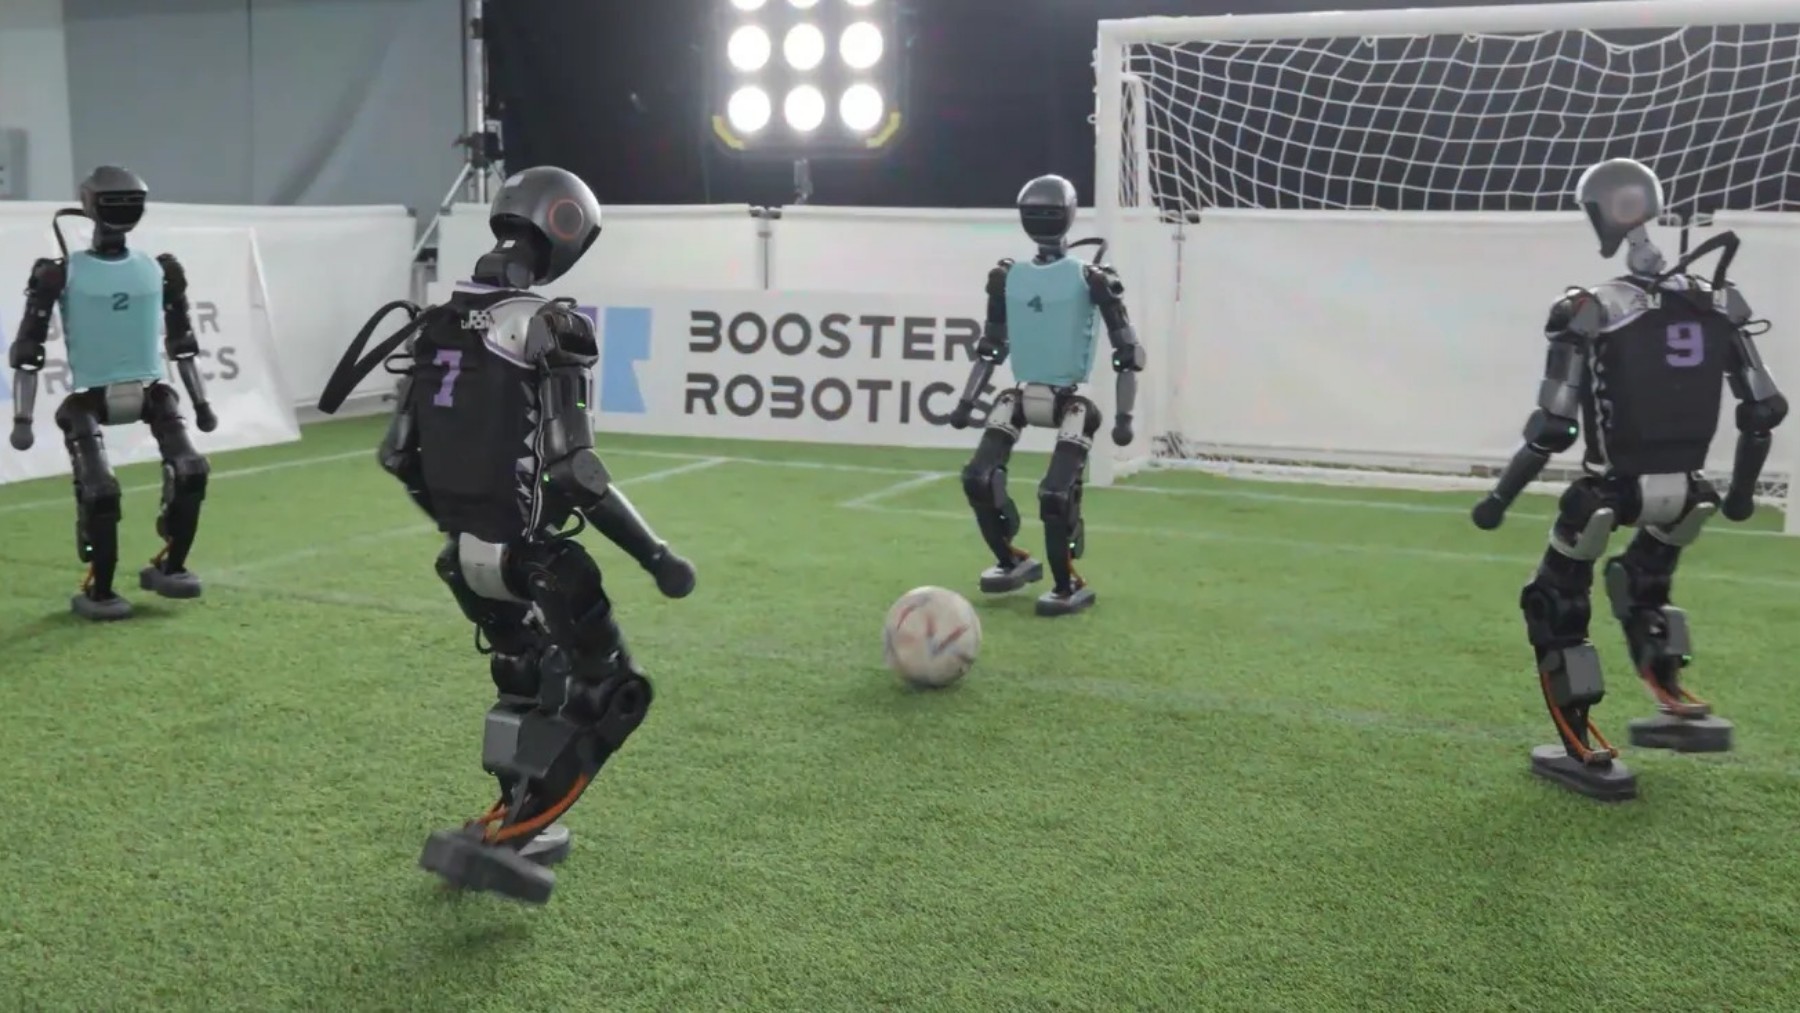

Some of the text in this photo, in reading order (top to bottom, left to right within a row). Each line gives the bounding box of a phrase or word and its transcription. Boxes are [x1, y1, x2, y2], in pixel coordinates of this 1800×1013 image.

[112, 292, 129, 311] 2
[1027, 295, 1043, 313] 4
[689, 310, 981, 361] BOOSTER
[1666, 321, 1704, 367] 9
[433, 349, 463, 407] 7
